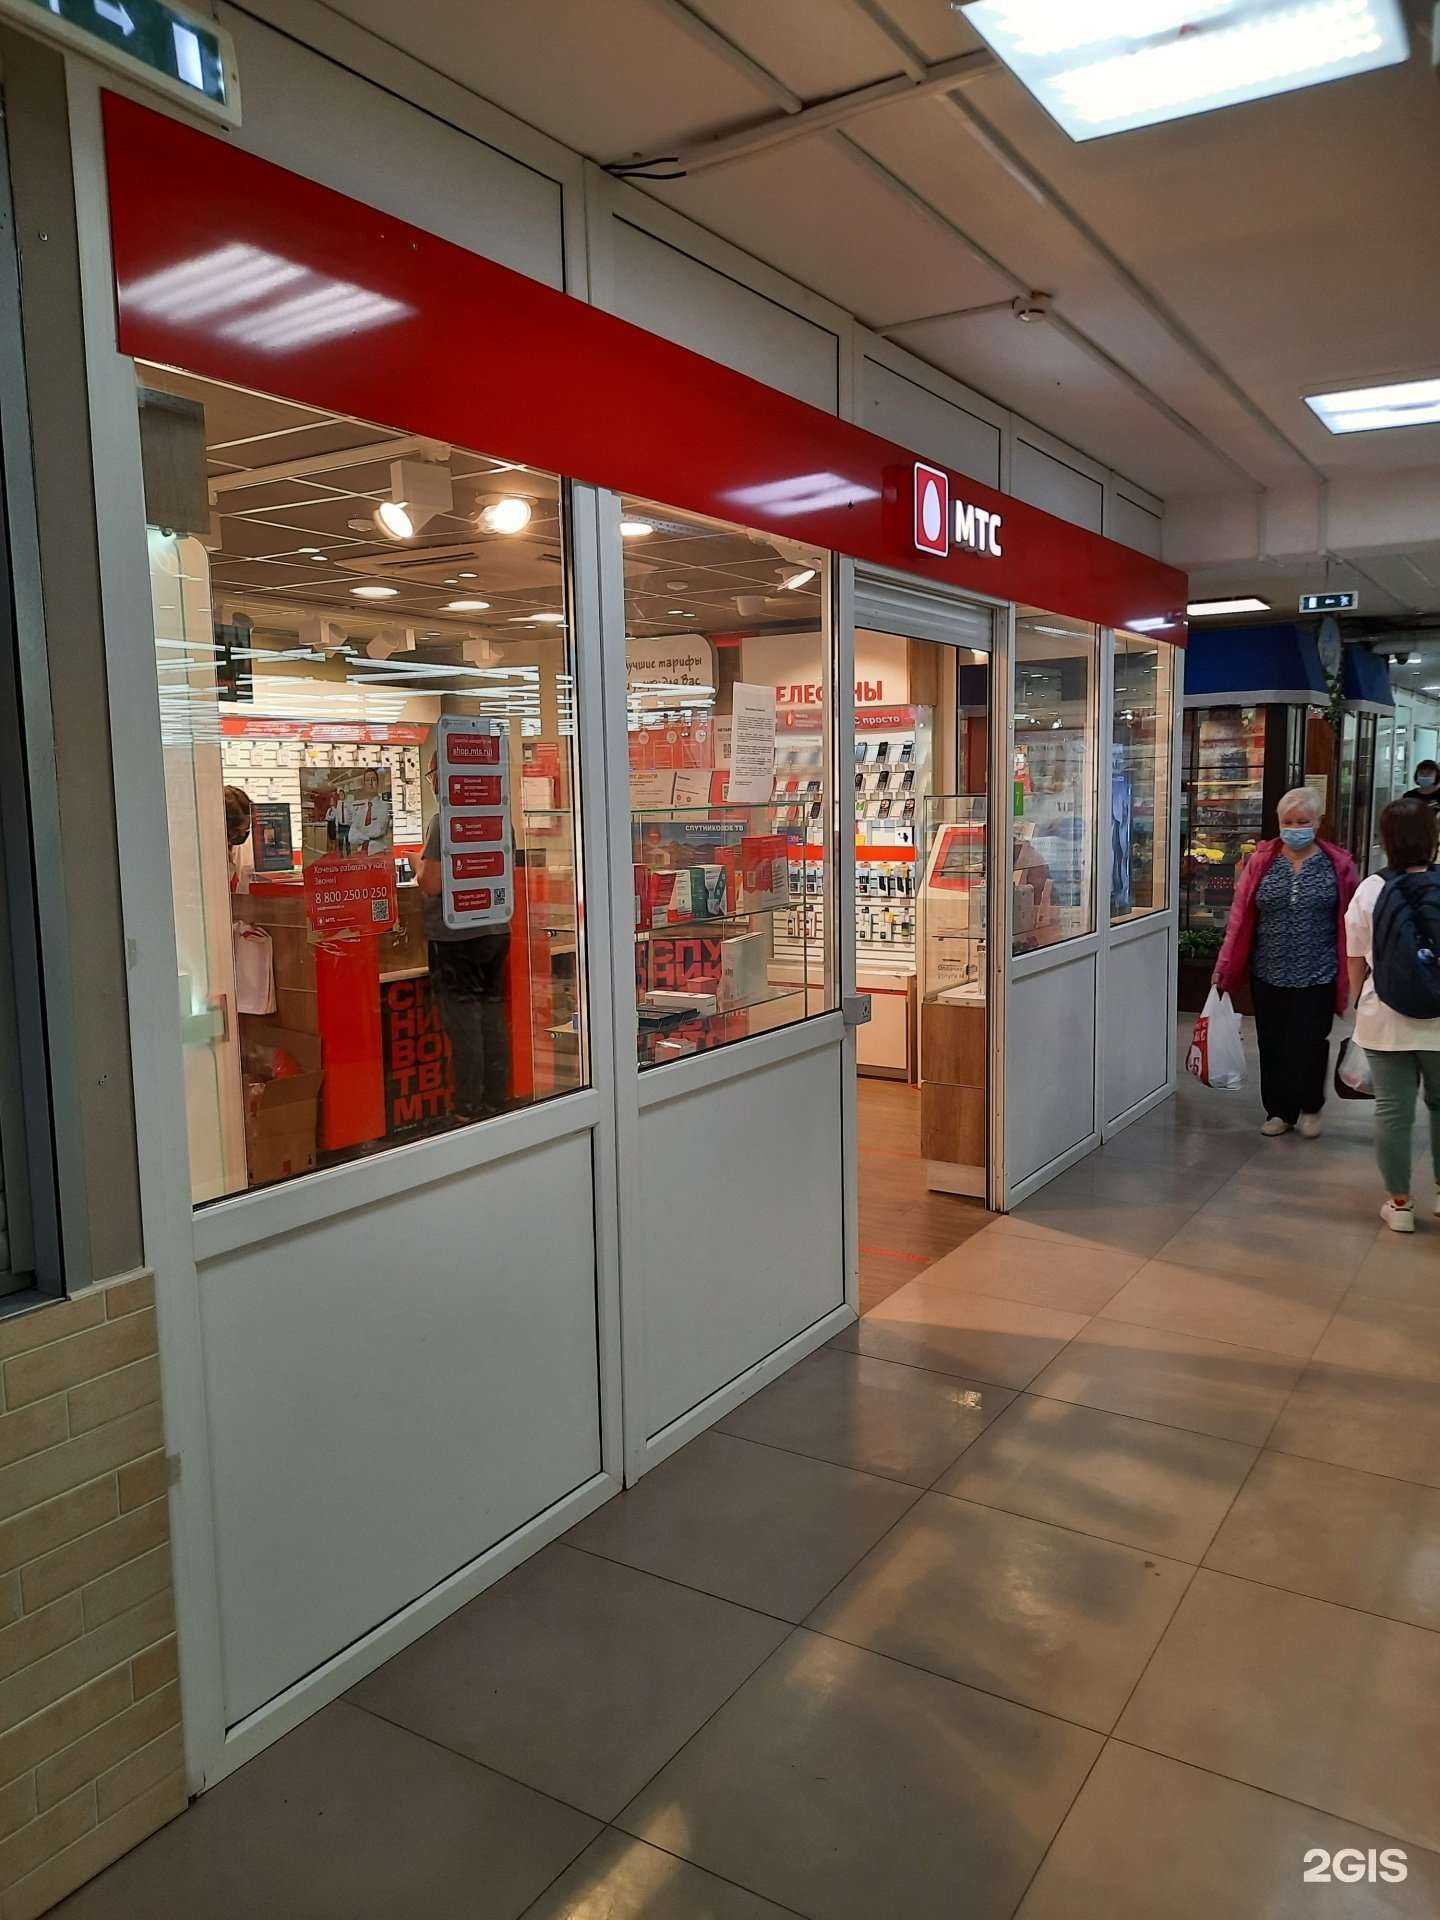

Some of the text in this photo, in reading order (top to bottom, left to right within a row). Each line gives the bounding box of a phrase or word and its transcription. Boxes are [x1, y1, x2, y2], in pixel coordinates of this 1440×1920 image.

[955, 499, 1002, 557] МТС
[658, 655, 702, 673] тарифы
[315, 886, 387, 904] 8 800 250 0 250
